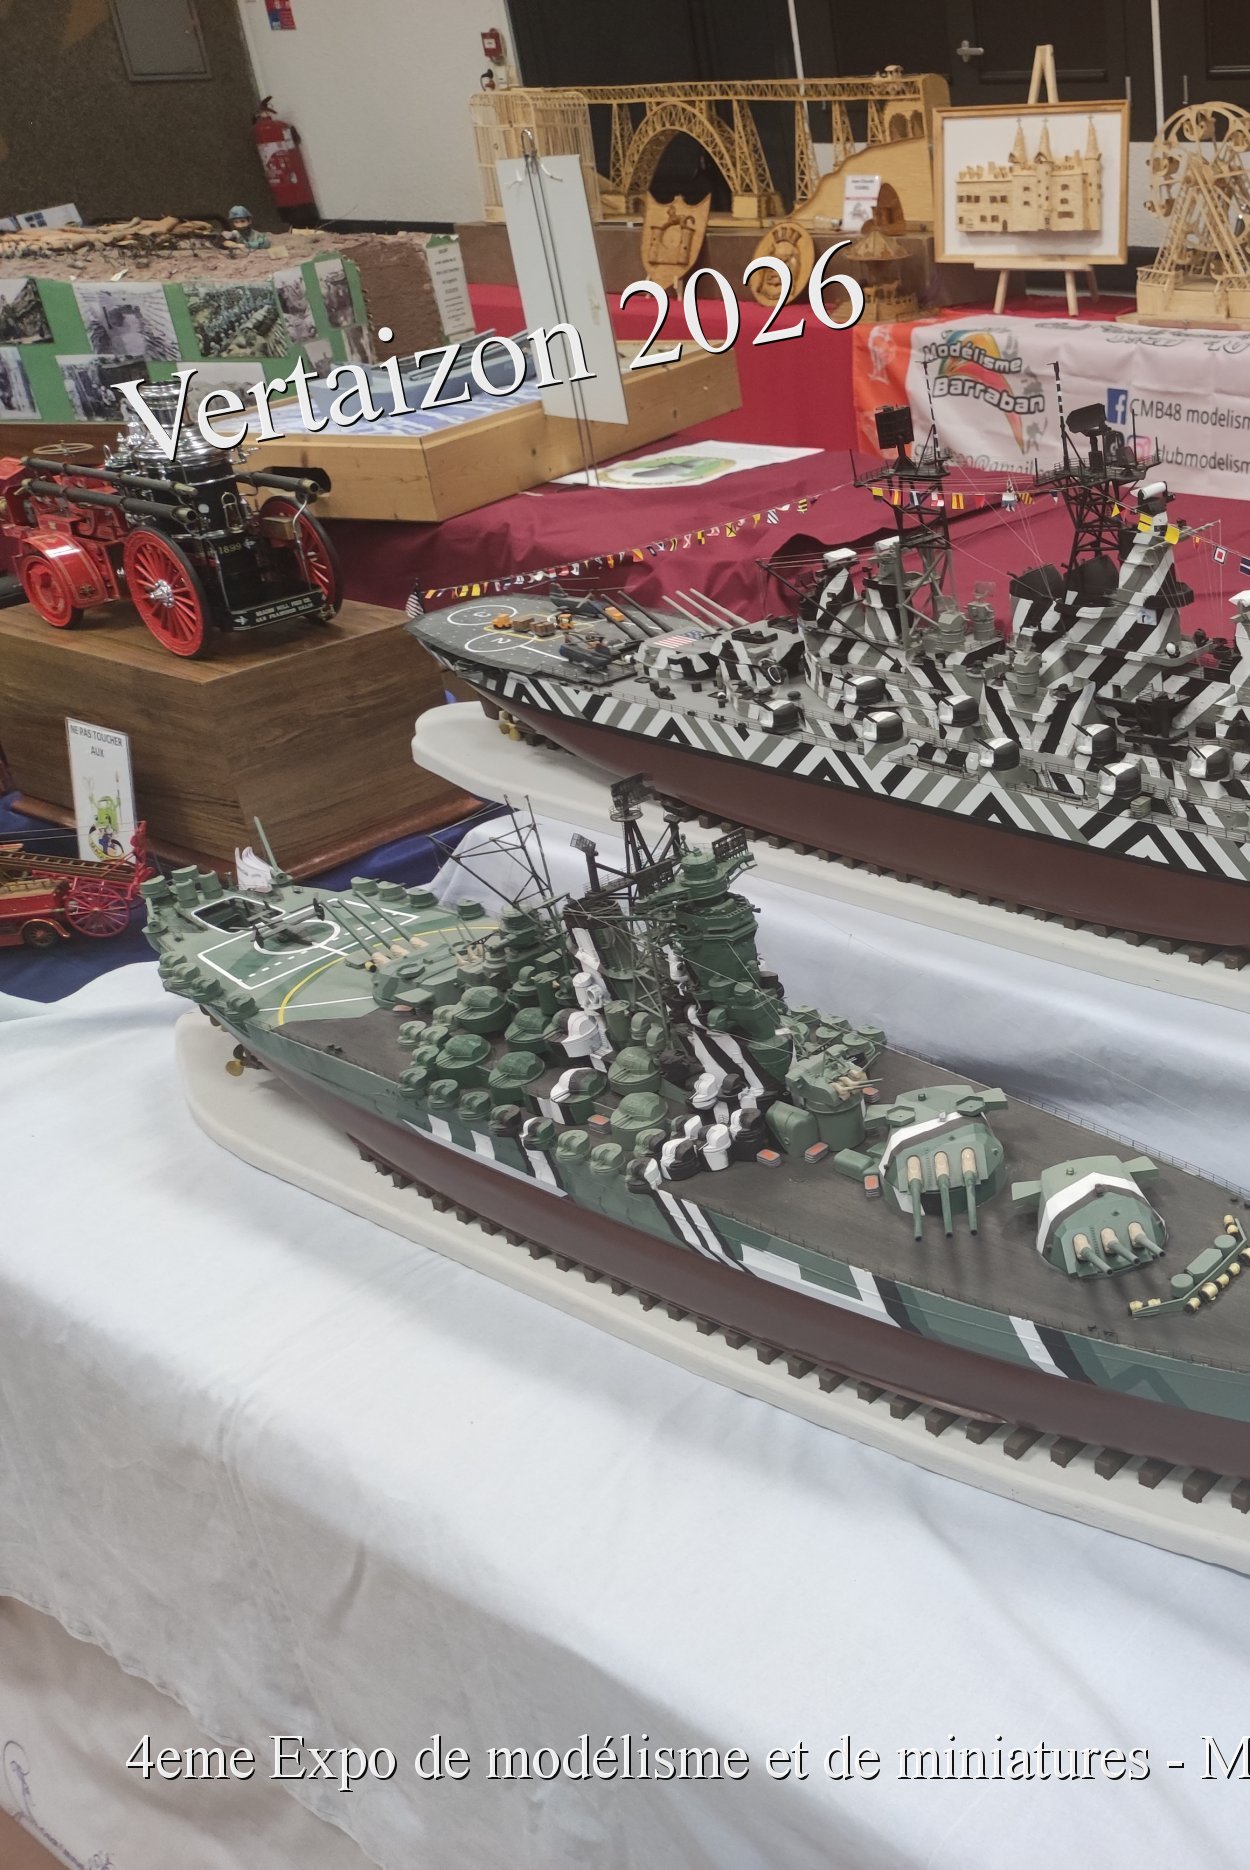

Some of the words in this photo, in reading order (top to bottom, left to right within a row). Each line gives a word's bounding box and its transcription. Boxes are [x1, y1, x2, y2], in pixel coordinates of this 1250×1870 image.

[923, 341, 1022, 374] Modélisme
[932, 376, 1045, 414] Barraban
[1130, 398, 1182, 422] CMB48
